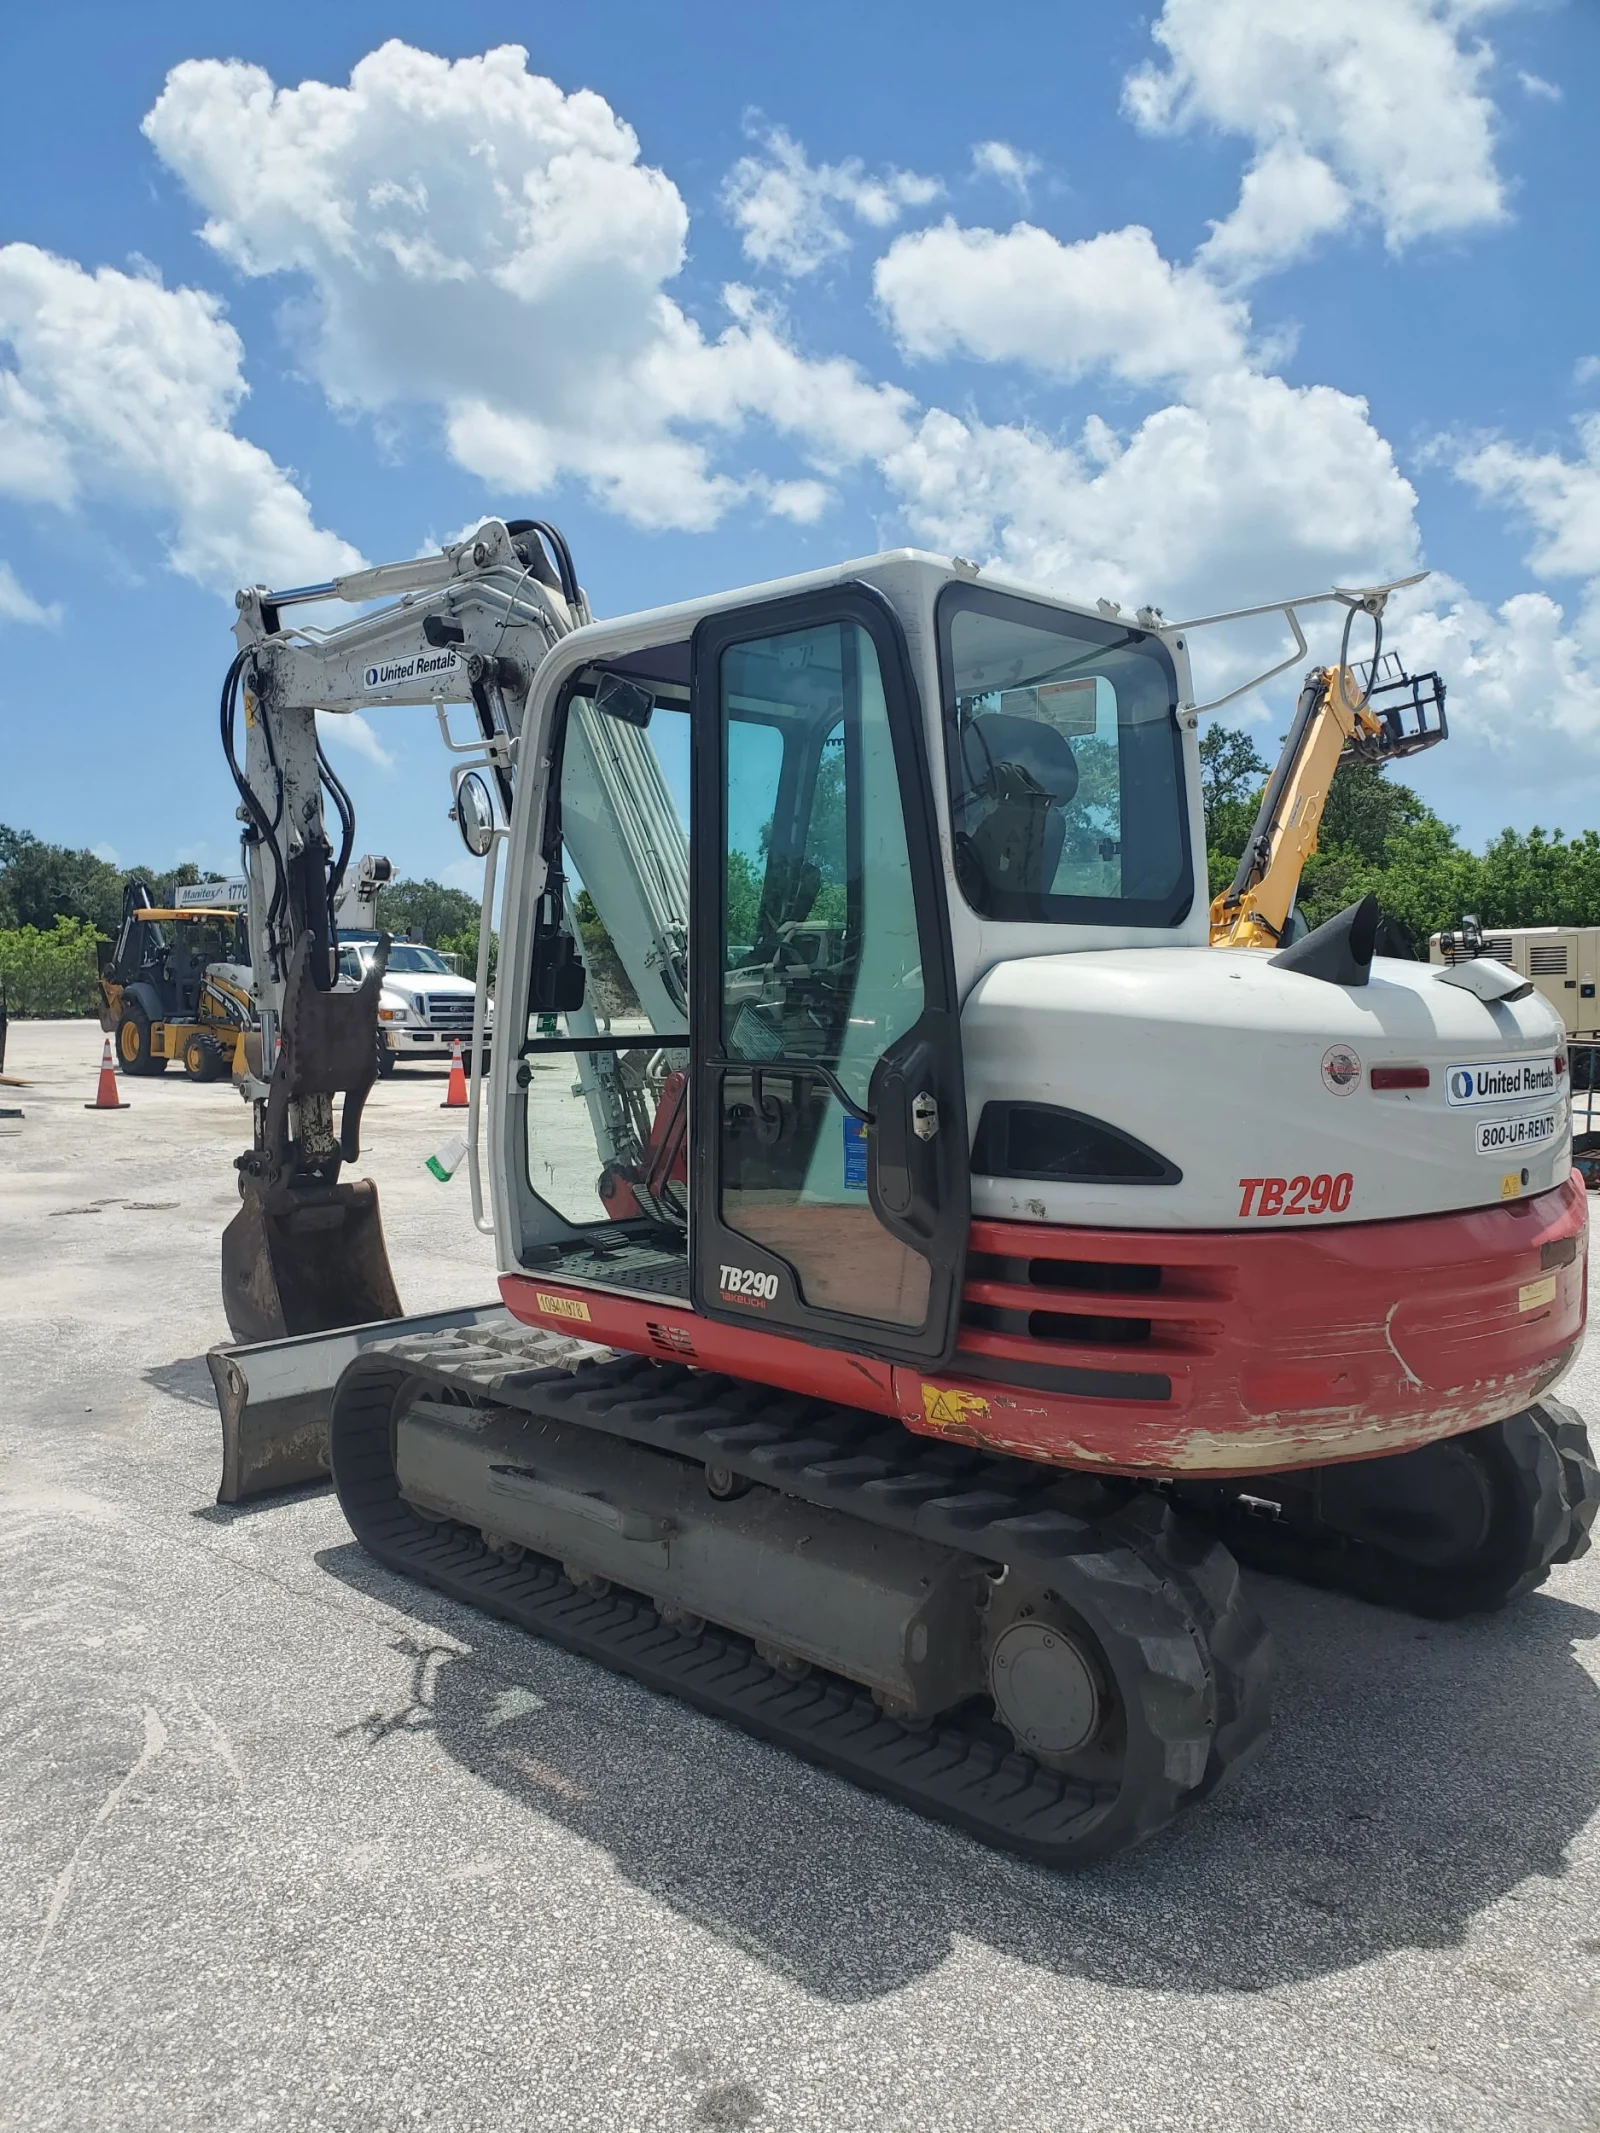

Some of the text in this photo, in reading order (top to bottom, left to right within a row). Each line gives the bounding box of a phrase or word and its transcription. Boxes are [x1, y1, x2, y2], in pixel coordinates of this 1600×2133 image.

[380, 652, 457, 682] United Rentals
[182, 888, 219, 902] Manitex
[1477, 1067, 1554, 1095] United Rentals
[1482, 1116, 1555, 1147] 800-UR-RENTS
[1238, 1173, 1354, 1217] TB290
[719, 1264, 779, 1300] TB290
